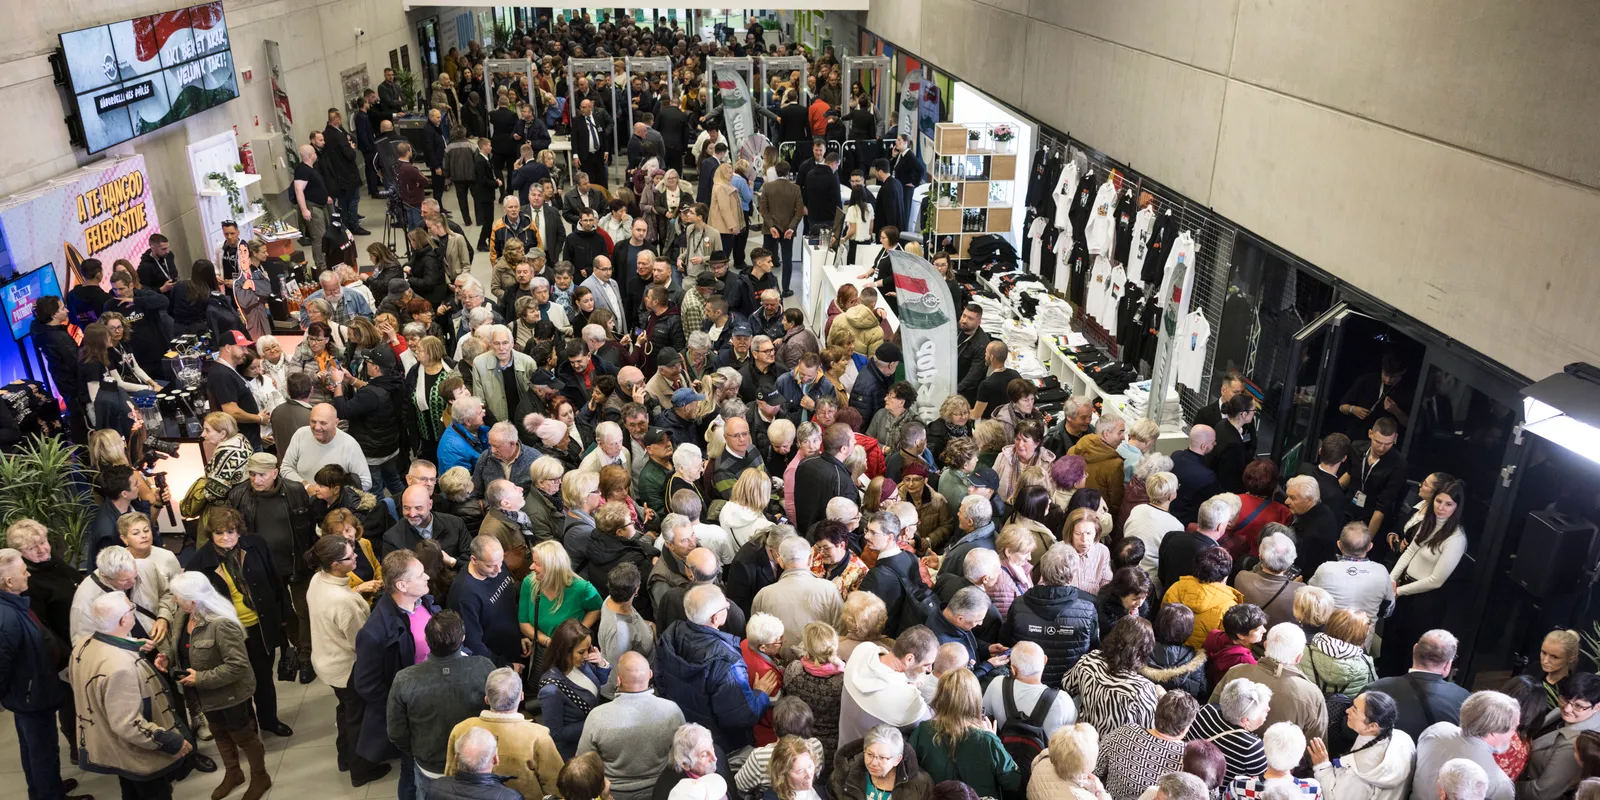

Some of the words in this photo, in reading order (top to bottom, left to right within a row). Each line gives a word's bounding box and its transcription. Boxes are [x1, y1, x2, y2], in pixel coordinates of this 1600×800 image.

[76, 194, 89, 224] A
[85, 187, 102, 219] TE
[100, 170, 144, 213] HANGOD
